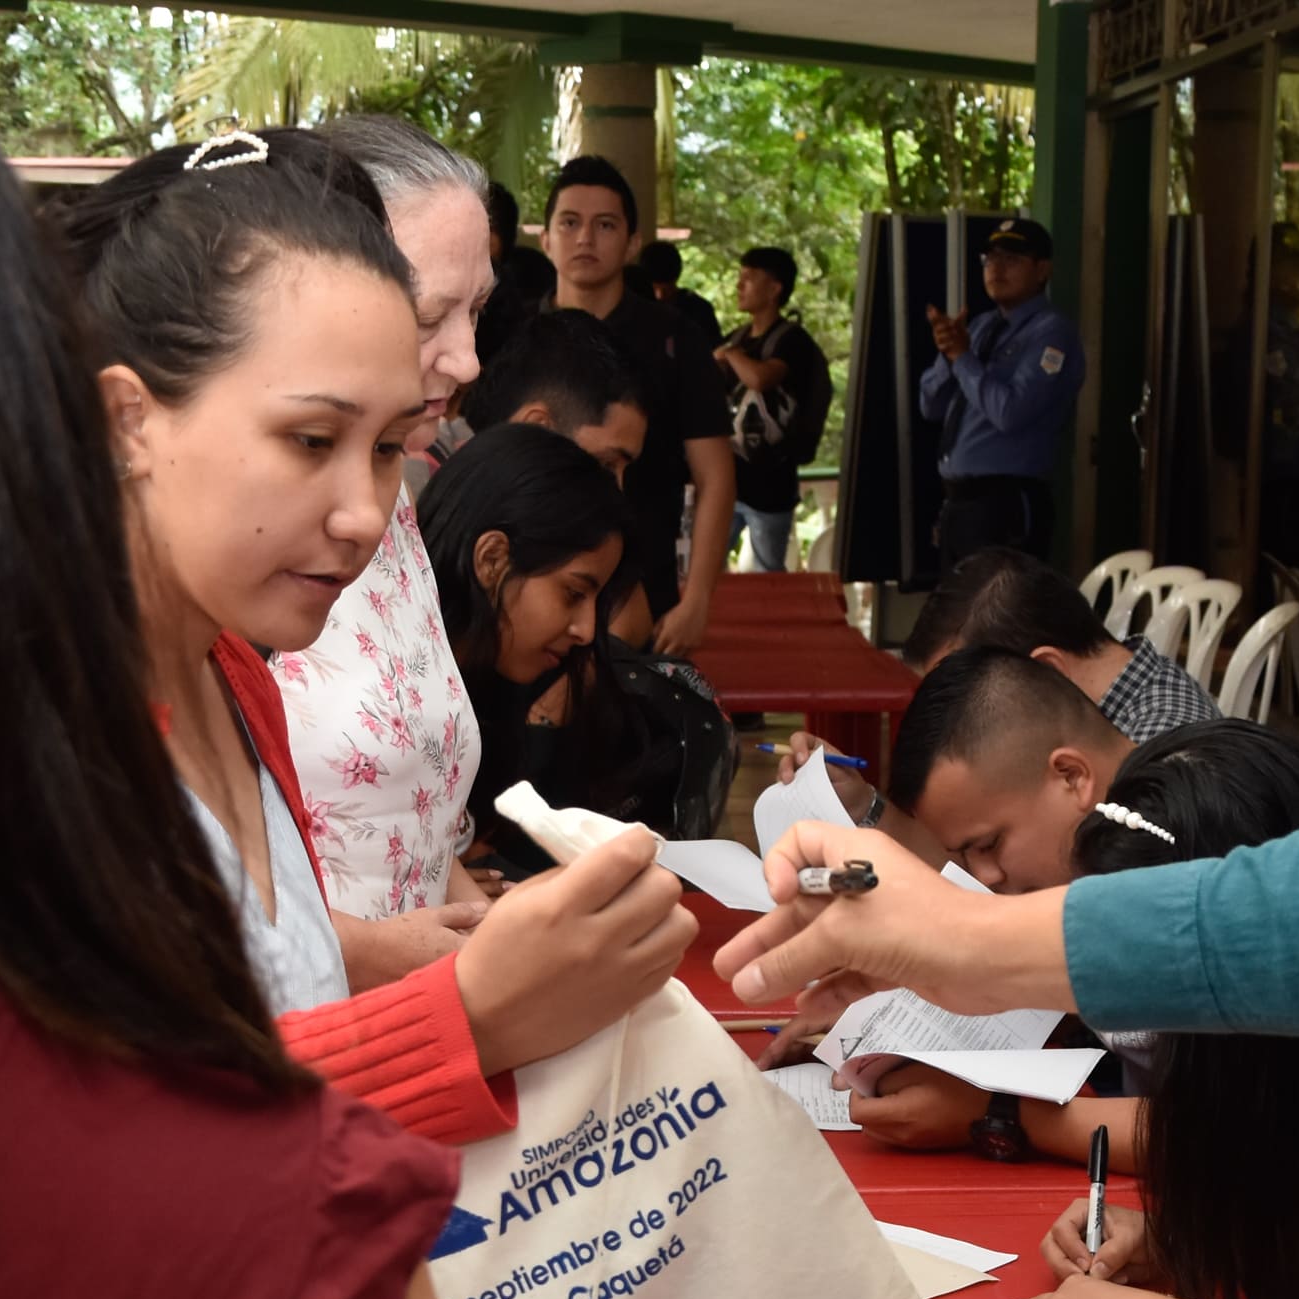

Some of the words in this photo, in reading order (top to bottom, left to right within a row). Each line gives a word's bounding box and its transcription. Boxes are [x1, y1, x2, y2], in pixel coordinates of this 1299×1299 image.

[498, 1081, 728, 1237] Amazonía
[510, 1097, 656, 1190] Universidades
[628, 1209, 666, 1239] de
[667, 1157, 728, 1217] 2022
